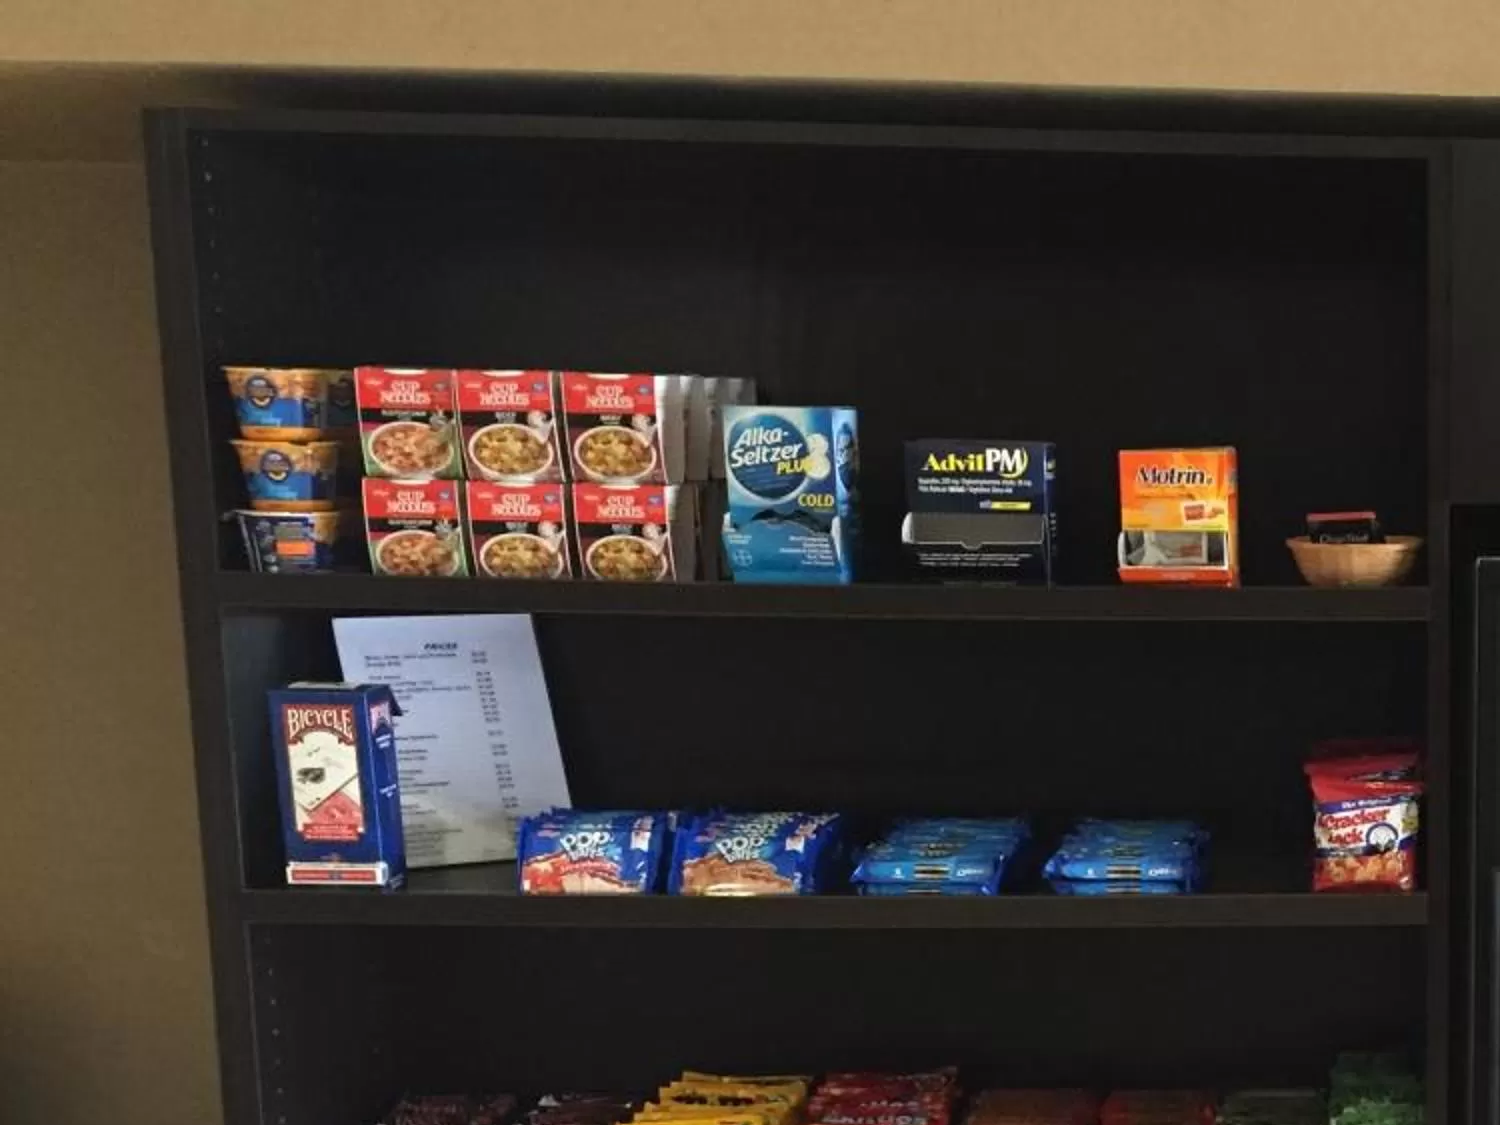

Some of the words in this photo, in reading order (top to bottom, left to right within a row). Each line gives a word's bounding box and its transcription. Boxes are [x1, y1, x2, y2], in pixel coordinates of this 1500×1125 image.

[734, 426, 789, 448] Alka-
[731, 442, 803, 468] Seltzer
[1136, 466, 1206, 485] Motrin
[798, 493, 835, 507] COLD
[286, 707, 353, 738] BICYCLE
